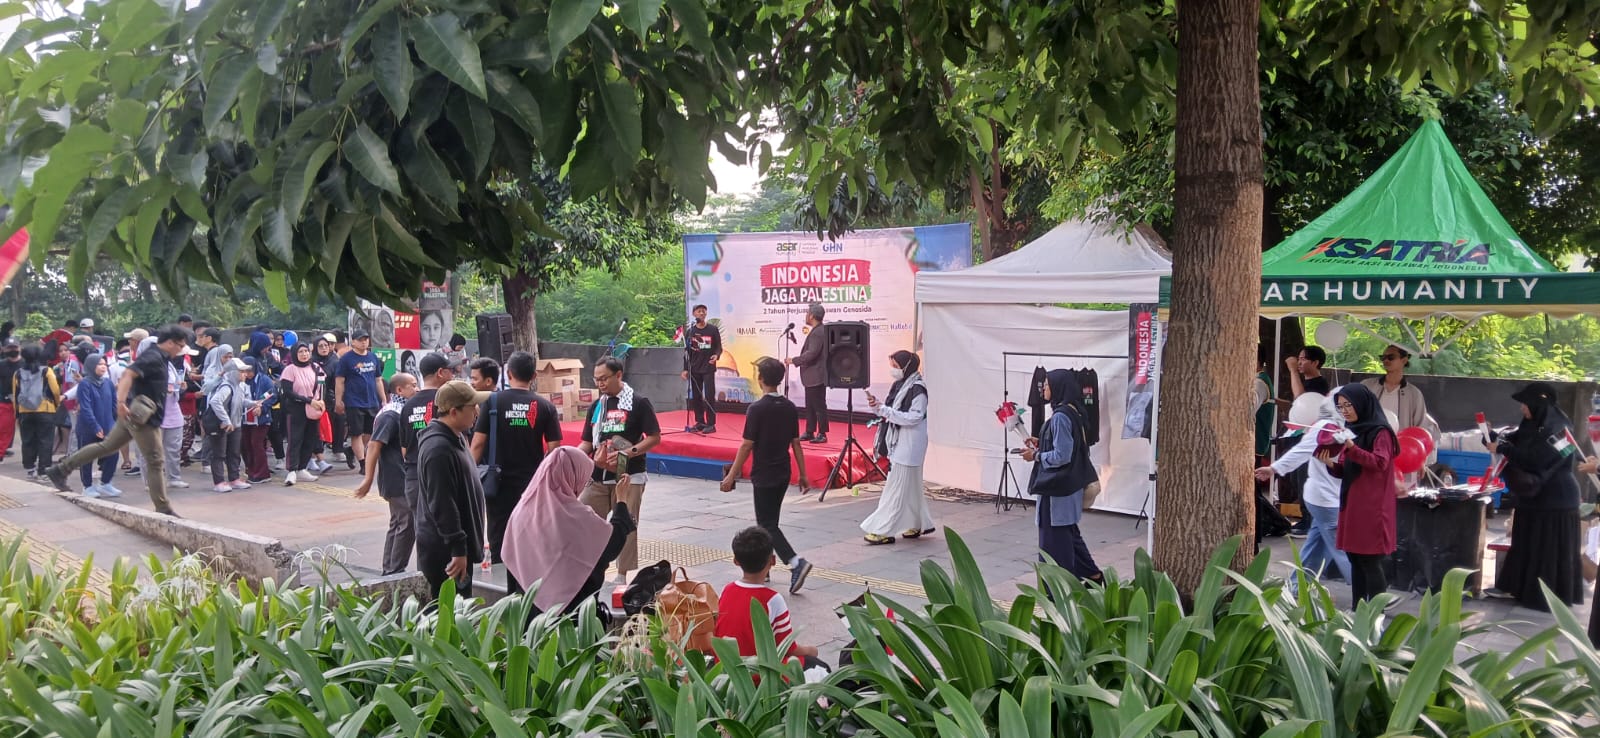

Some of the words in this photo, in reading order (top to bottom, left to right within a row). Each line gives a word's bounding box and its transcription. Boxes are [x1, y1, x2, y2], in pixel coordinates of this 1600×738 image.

[776, 242, 797, 251] asar
[822, 243, 843, 252] GHN
[1432, 263, 1488, 271] INDONESIA
[771, 263, 859, 285] INDONESIA
[1263, 282, 1309, 301] AR
[1323, 278, 1539, 301] HUMANITY
[764, 288, 797, 303] JAGA
[800, 286, 868, 302] PALESTINA
[768, 307, 786, 315] Tahun
[842, 305, 872, 313] Genosida
[1137, 320, 1149, 377] INDONESIA
[412, 405, 427, 414] INDO
[512, 403, 530, 411] INDO
[408, 413, 425, 423] NESIA
[505, 410, 527, 419] NESIA
[509, 418, 529, 426] JAGA
